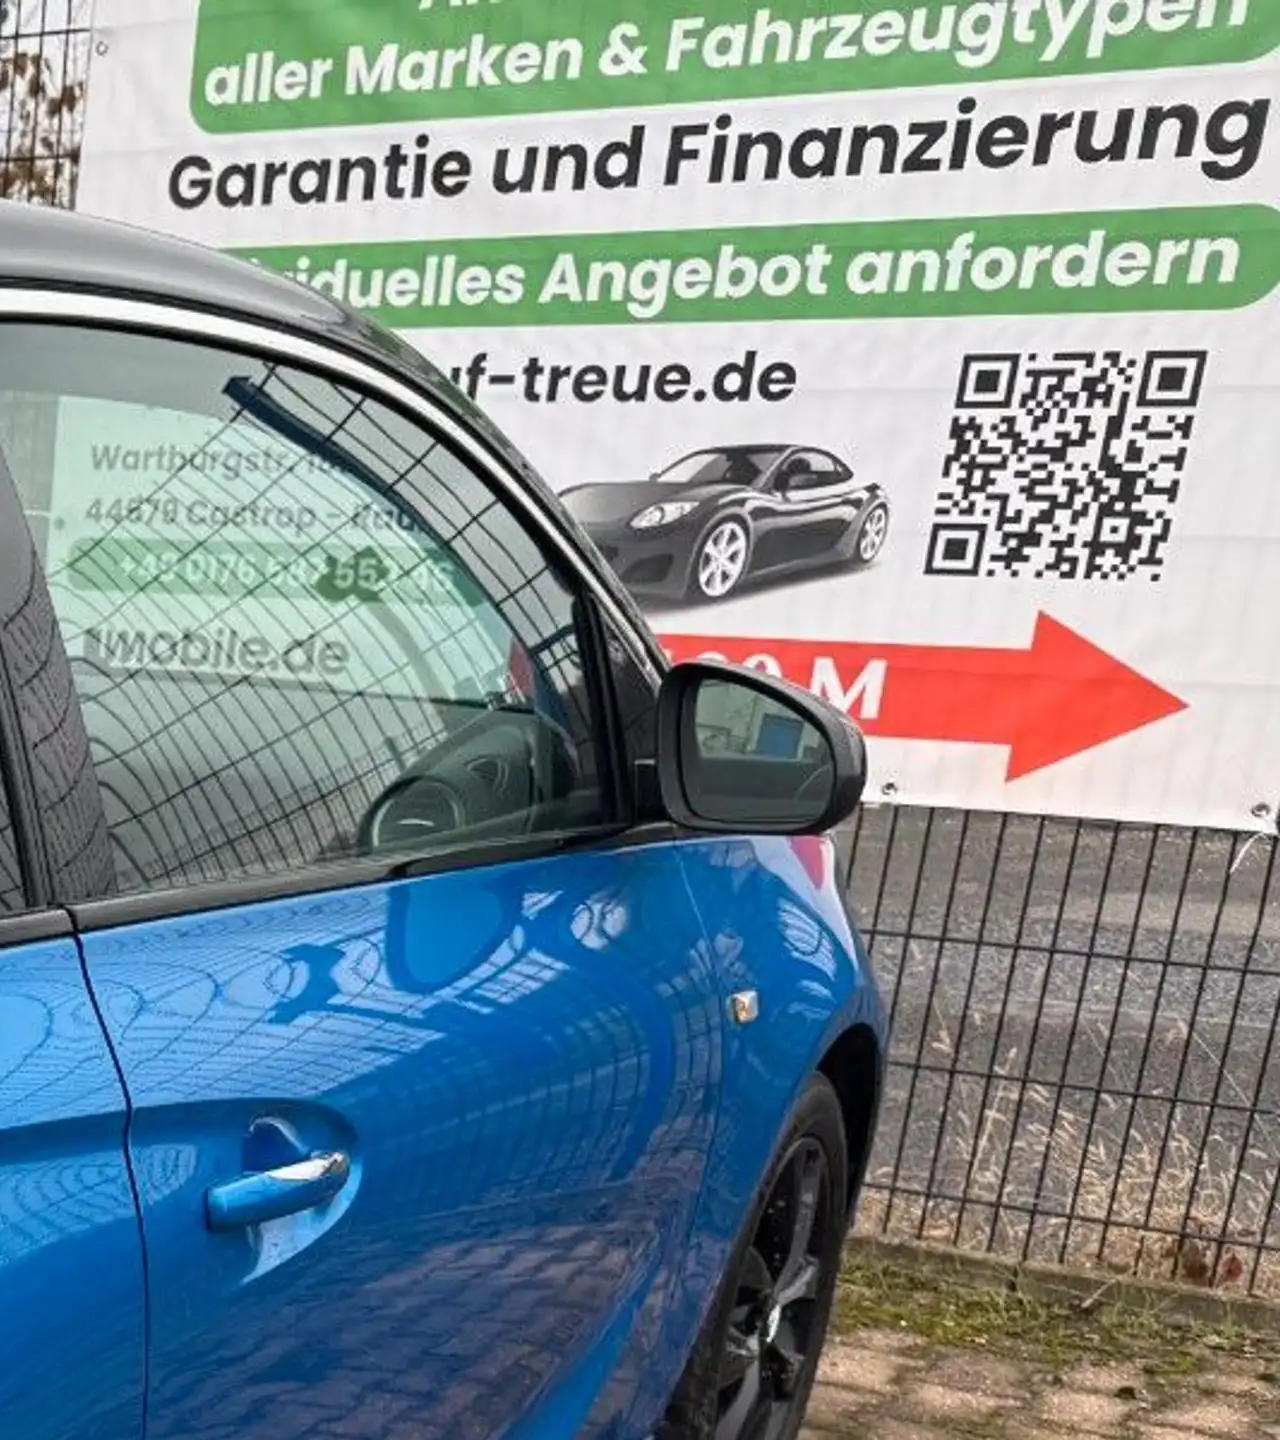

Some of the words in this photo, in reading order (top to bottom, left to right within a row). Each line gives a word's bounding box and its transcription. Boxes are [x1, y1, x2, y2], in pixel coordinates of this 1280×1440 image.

[203, 52, 334, 107] aller
[345, 33, 584, 96] Marken
[597, 21, 648, 77] &
[665, 0, 1250, 73] Fahrzeugtypen
[168, 133, 473, 210] Garantie
[491, 124, 646, 194] und
[663, 96, 1272, 187] Finanzierung
[250, 253, 526, 309] iduelles
[537, 244, 832, 320] Angebot
[845, 230, 1241, 295] anfordern
